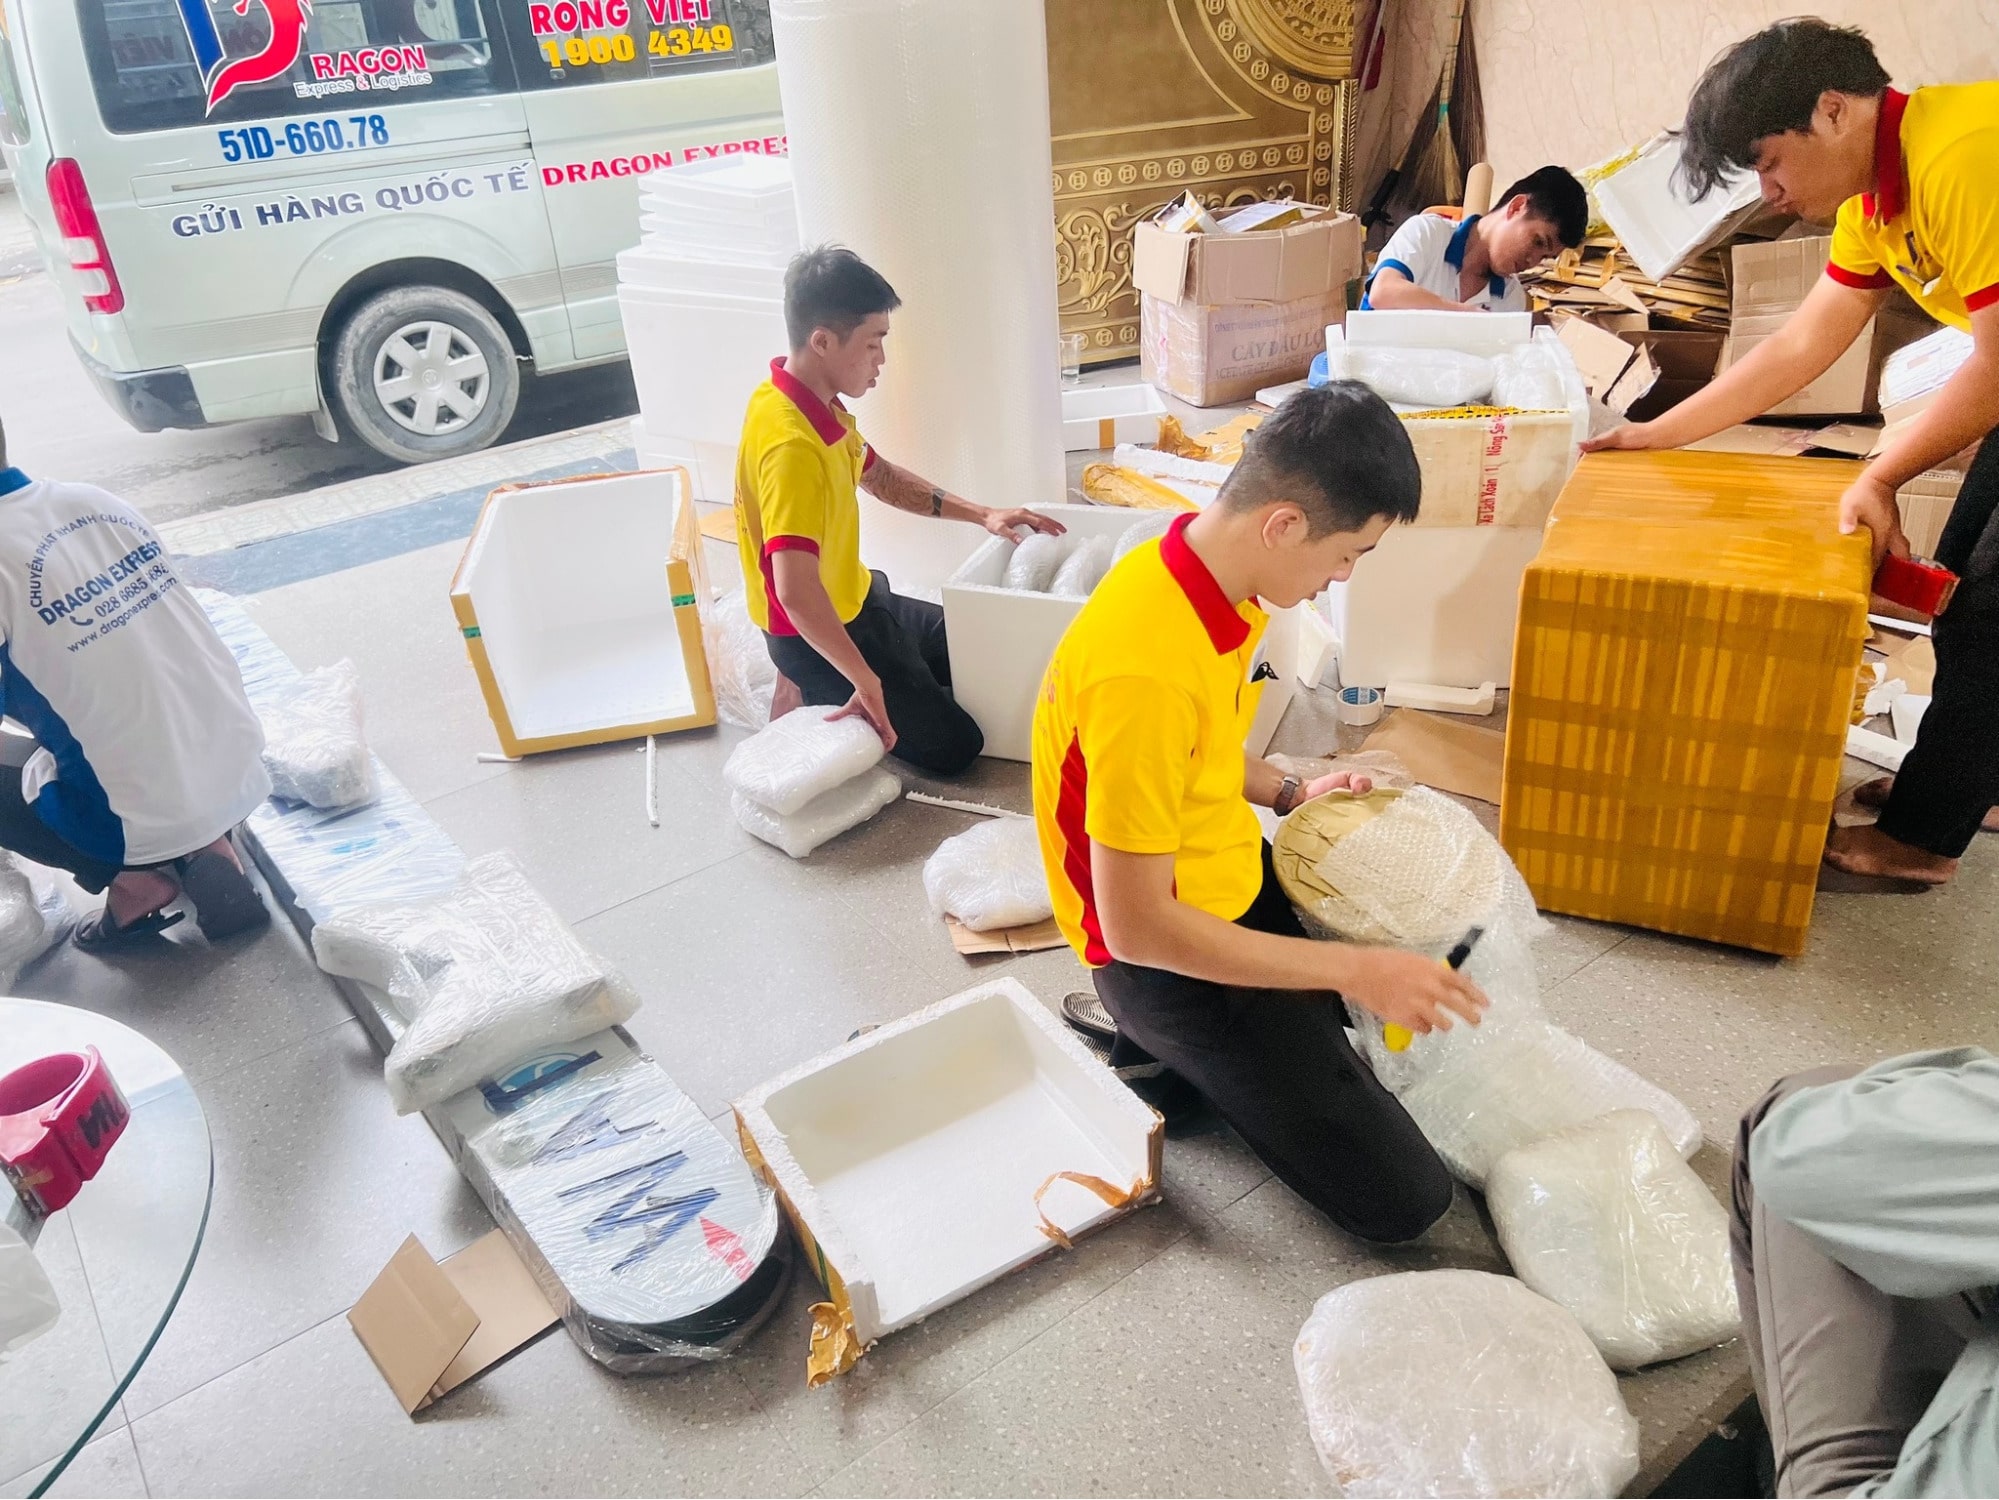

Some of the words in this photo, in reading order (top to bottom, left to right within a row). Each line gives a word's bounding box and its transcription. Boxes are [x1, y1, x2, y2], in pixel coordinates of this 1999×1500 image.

[541, 34, 635, 67] 1900
[648, 25, 733, 57] 4349
[294, 79, 355, 98] Express
[356, 75, 369, 90] &
[371, 72, 432, 91] Logistics
[218, 114, 390, 162] 51D-660.78
[542, 151, 673, 187] DRAGON
[172, 203, 243, 237] GỬI
[256, 192, 364, 228] HÀNG
[375, 173, 474, 210] QUỐC
[484, 162, 529, 193] TẾ
[56, 514, 98, 539] NHANH
[37, 573, 115, 626] DRAGON
[94, 596, 121, 618] 028
[119, 577, 149, 603] 6685
